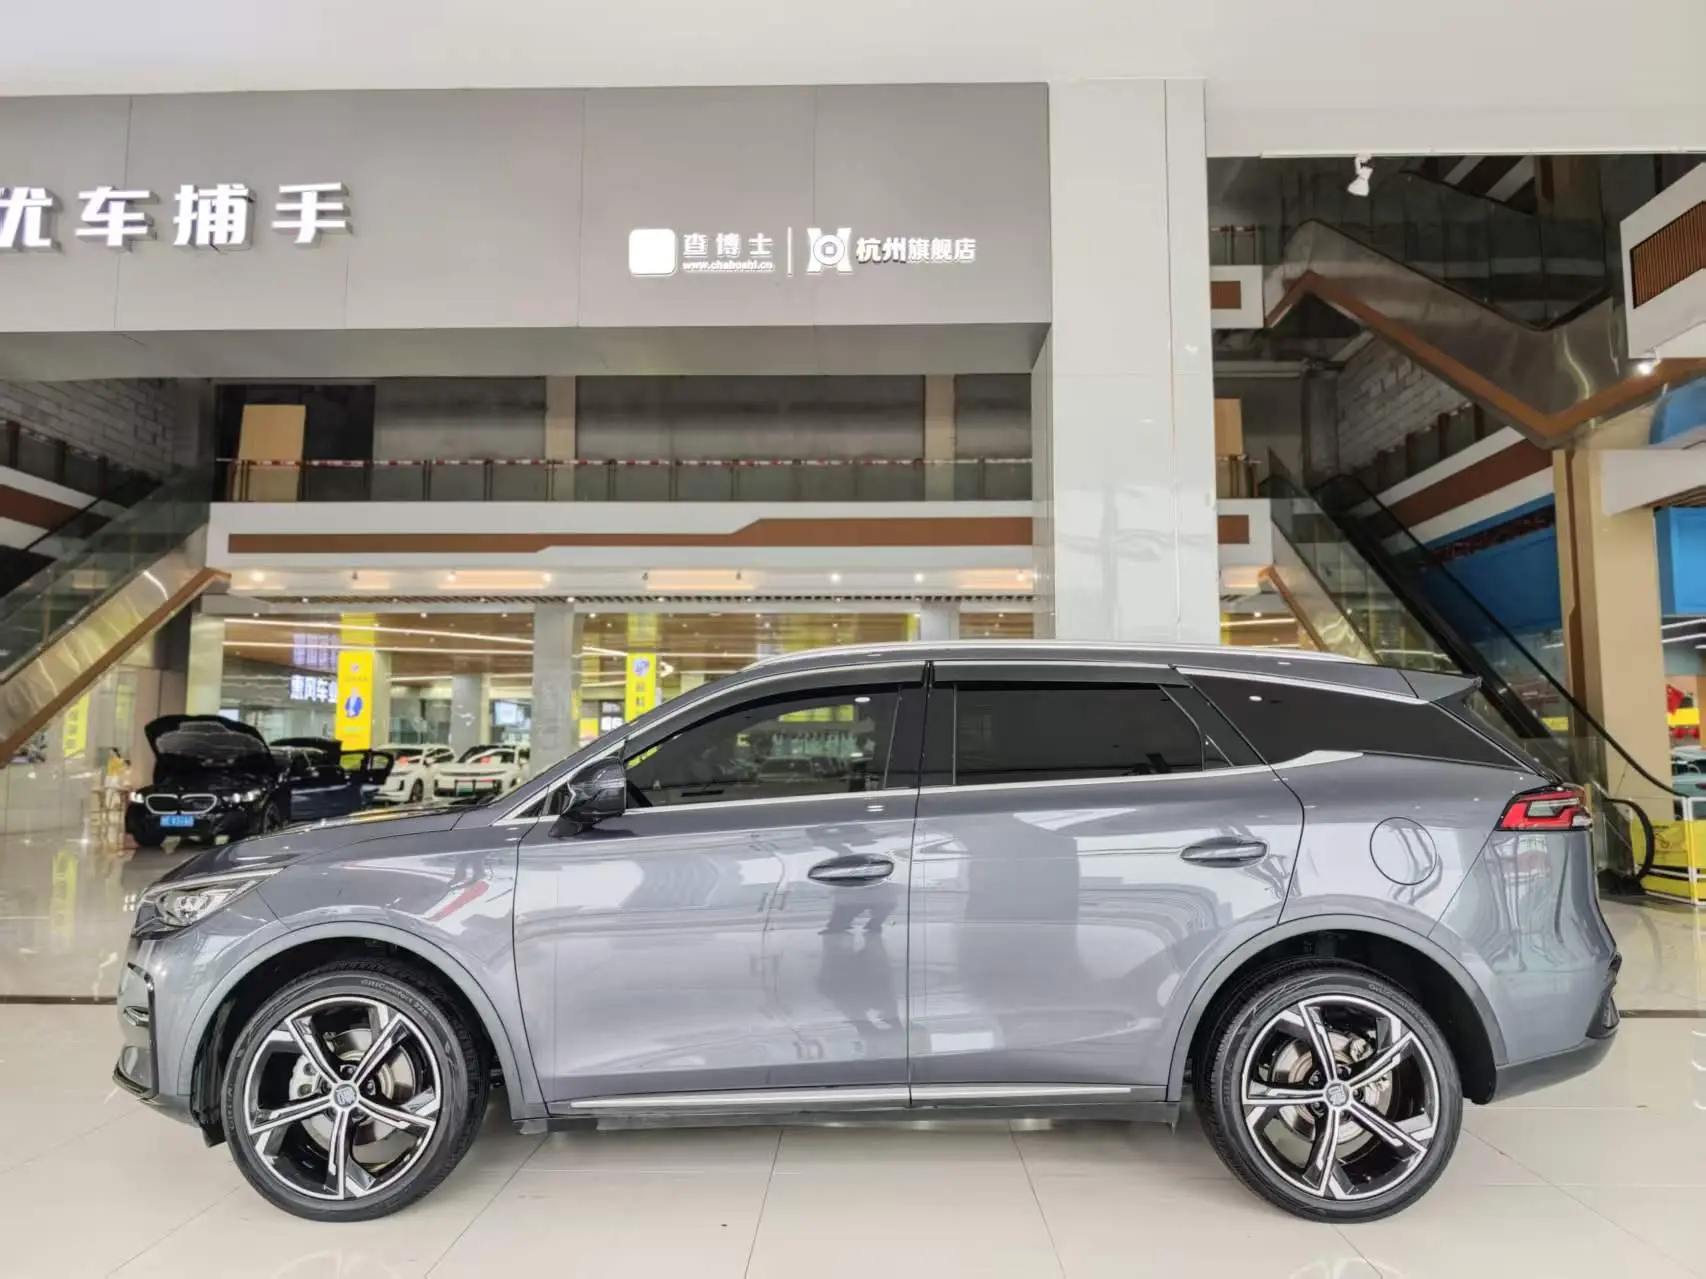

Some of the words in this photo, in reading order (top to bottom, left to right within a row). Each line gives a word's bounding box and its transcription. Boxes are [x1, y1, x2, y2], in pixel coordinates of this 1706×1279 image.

[0, 183, 347, 247] 优车捕手
[683, 232, 773, 257] 查博士
[856, 237, 977, 263] 杭州旗舰店
